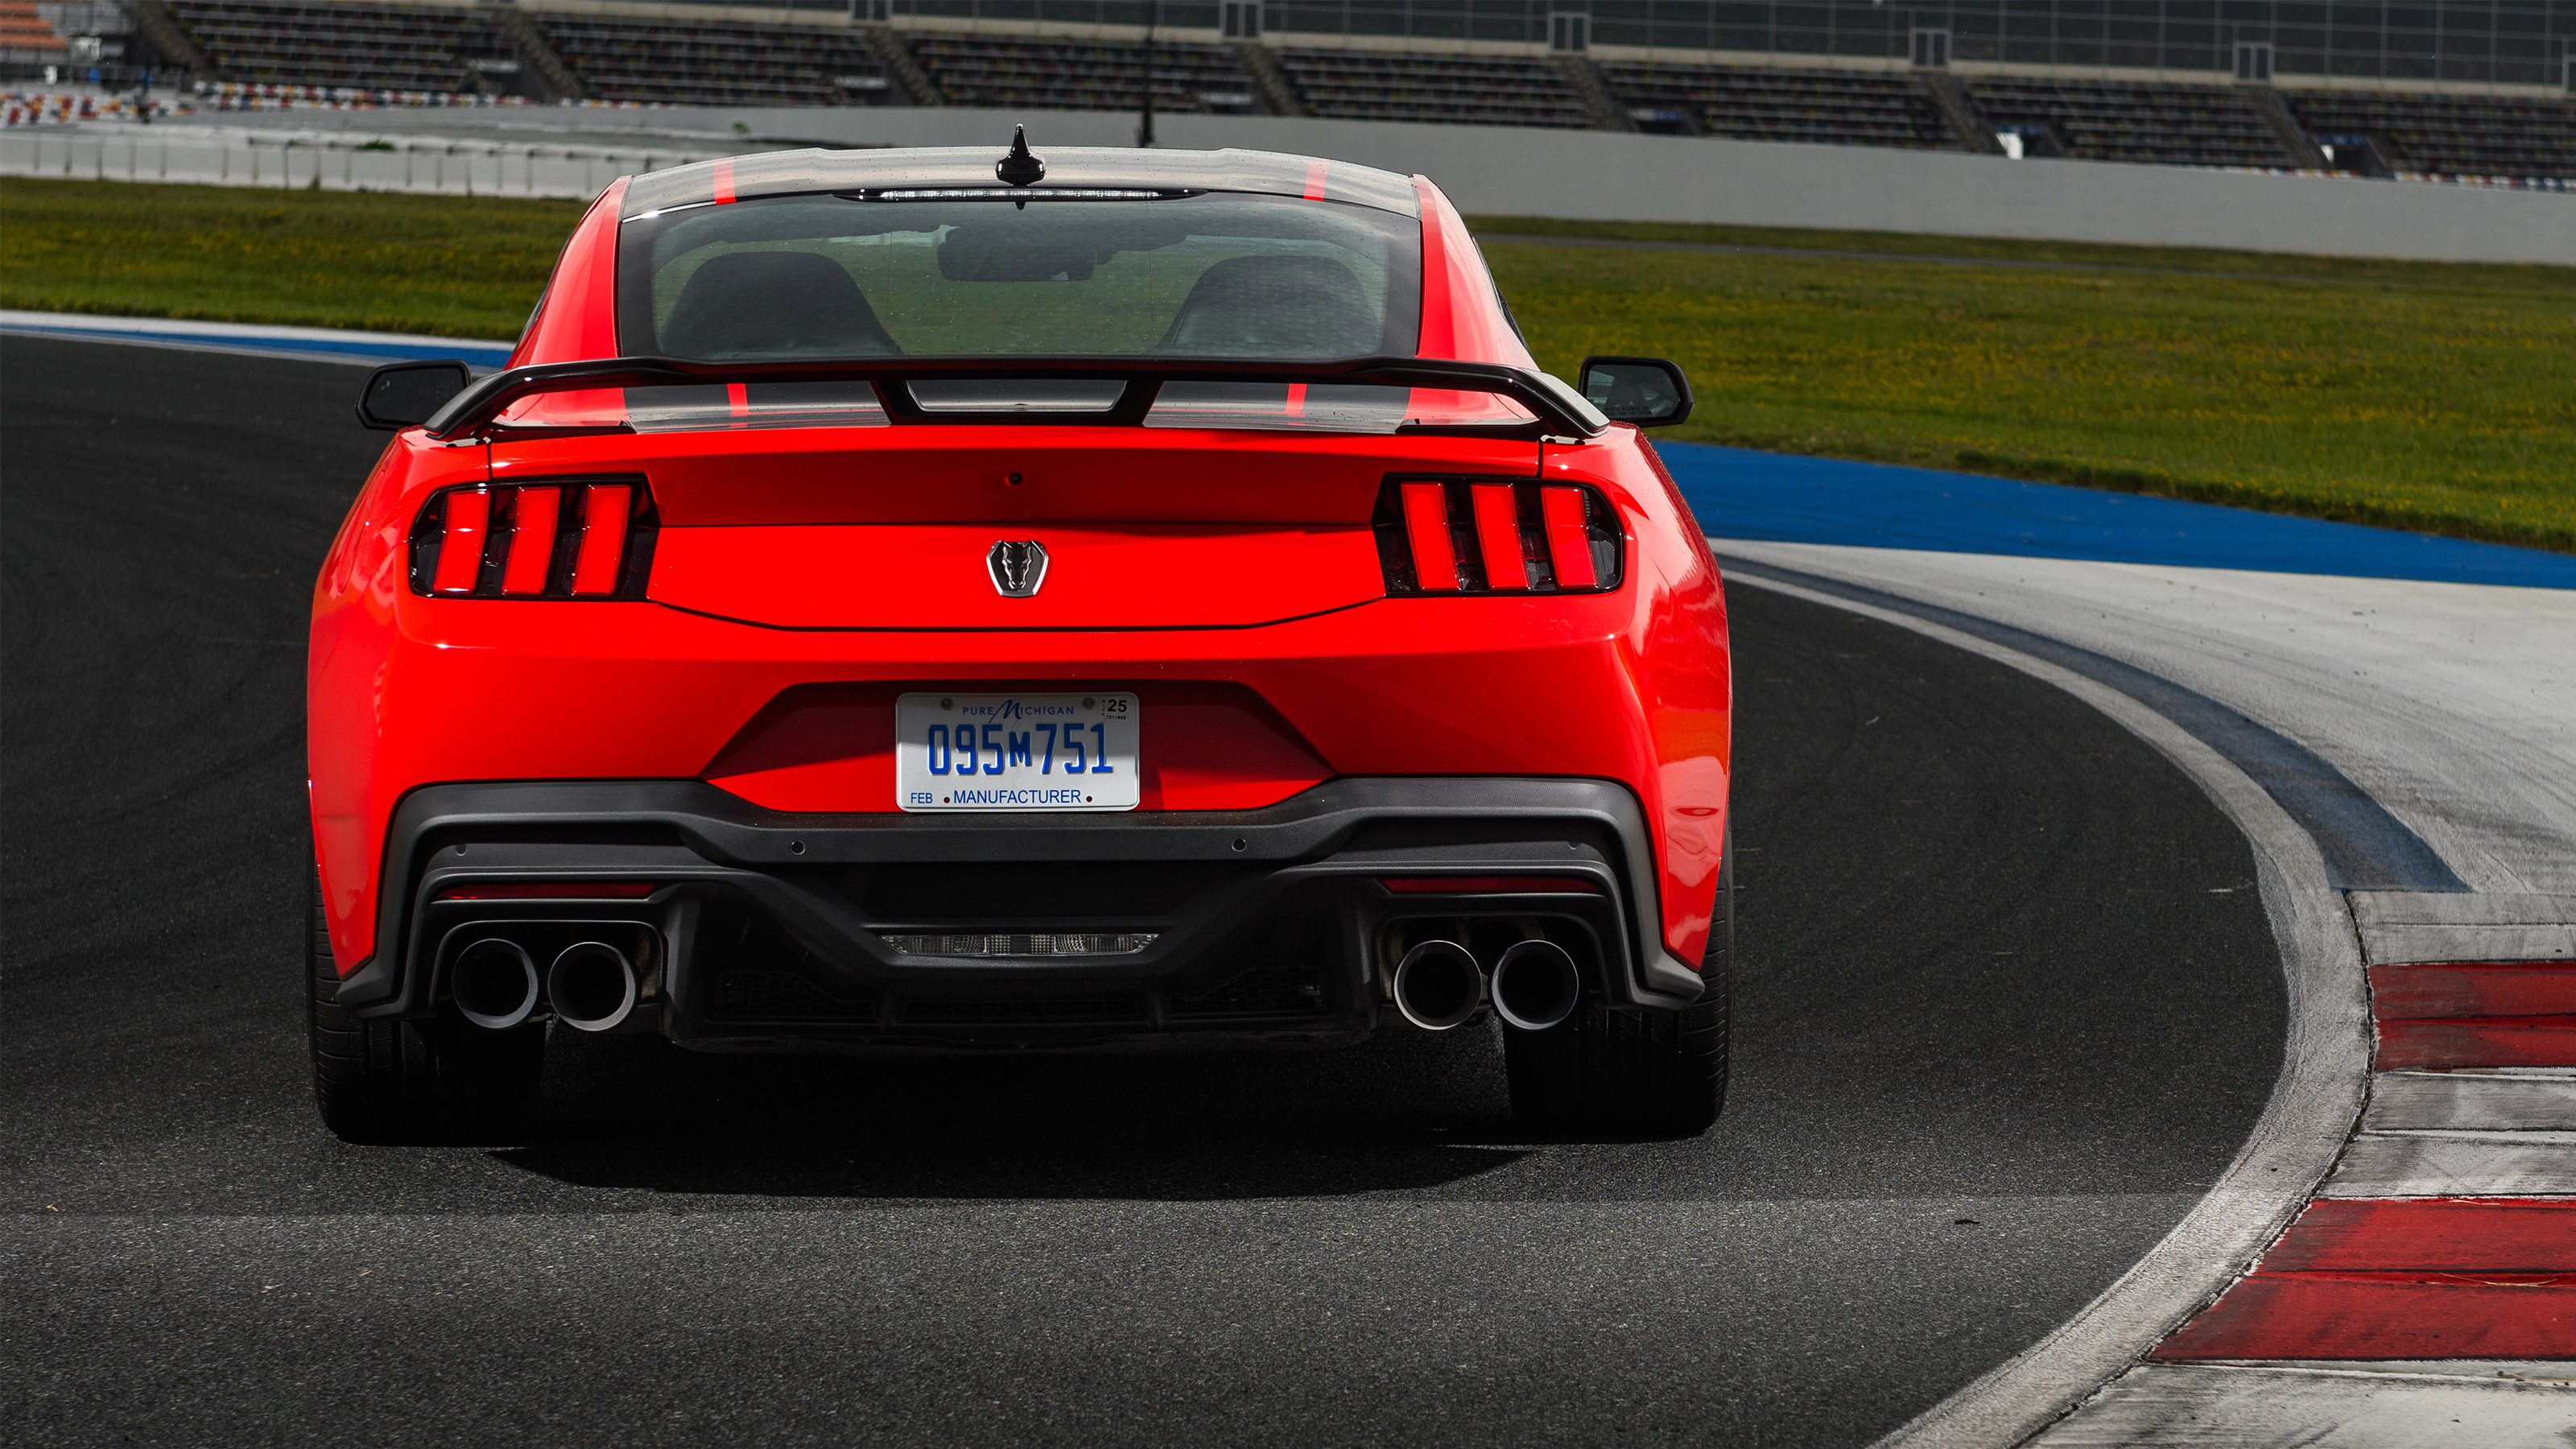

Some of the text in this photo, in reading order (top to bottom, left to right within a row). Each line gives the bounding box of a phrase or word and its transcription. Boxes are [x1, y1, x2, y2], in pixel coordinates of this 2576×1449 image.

[963, 699, 1074, 723] PURE MICHIGAN
[1107, 700, 1127, 712] 25
[928, 723, 1113, 774] 095M751
[910, 790, 1081, 803] FEB MANUFACTURER
